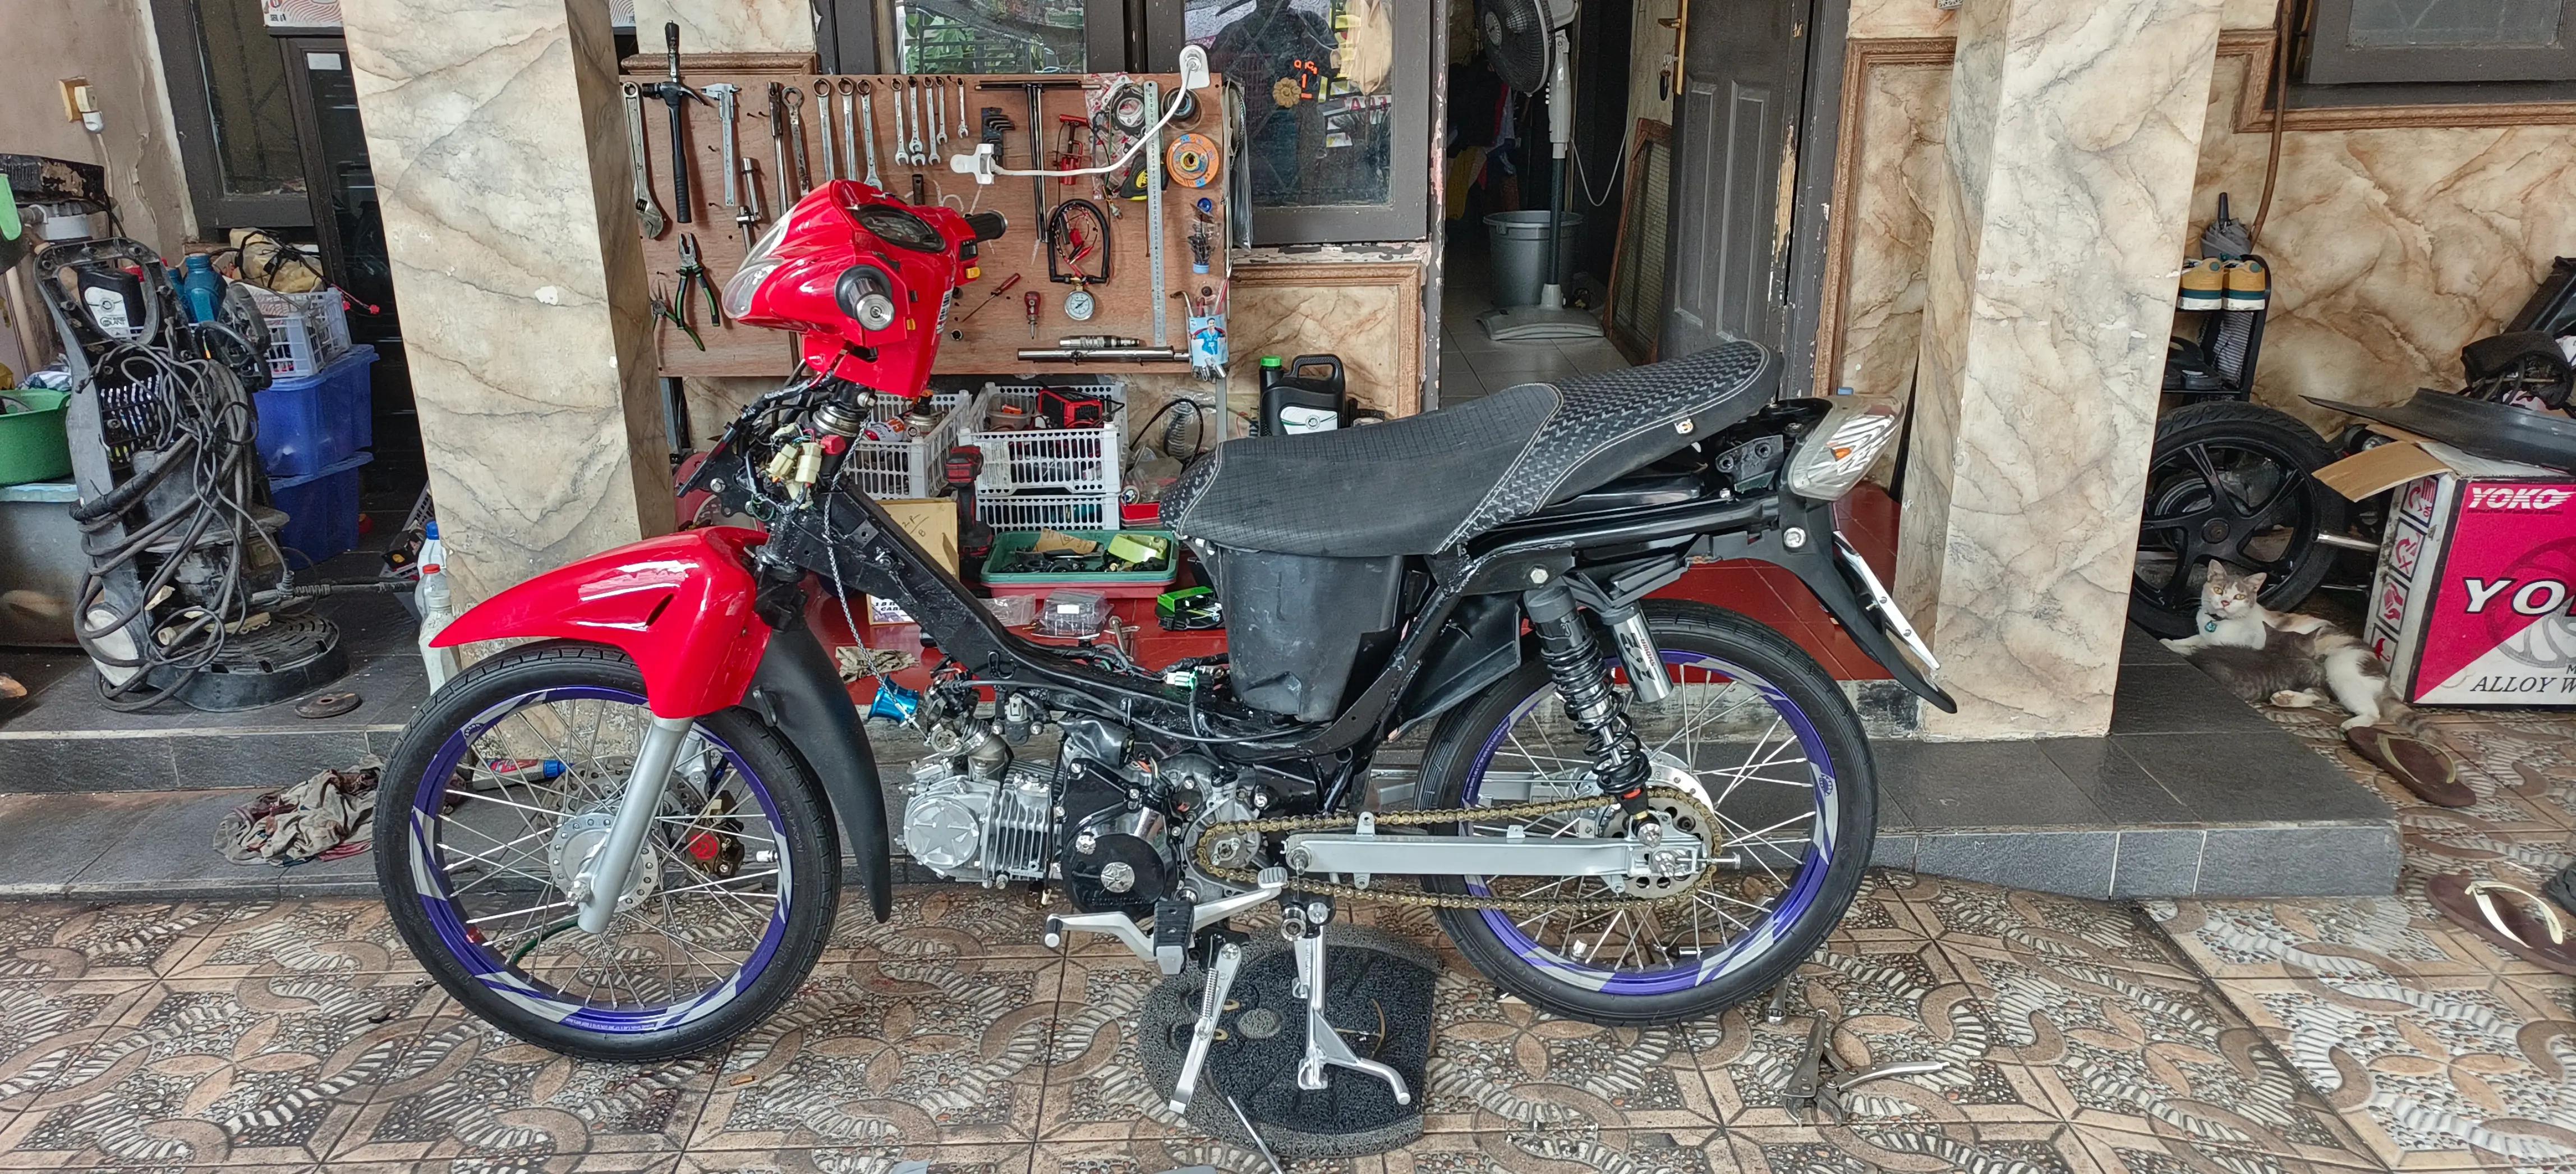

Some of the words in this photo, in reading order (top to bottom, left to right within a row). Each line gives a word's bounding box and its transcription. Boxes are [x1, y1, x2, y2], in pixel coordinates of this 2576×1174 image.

[2468, 487, 2576, 510] YOKO
[2463, 577, 2576, 617] YO
[2469, 676, 2557, 693] ALLOY
